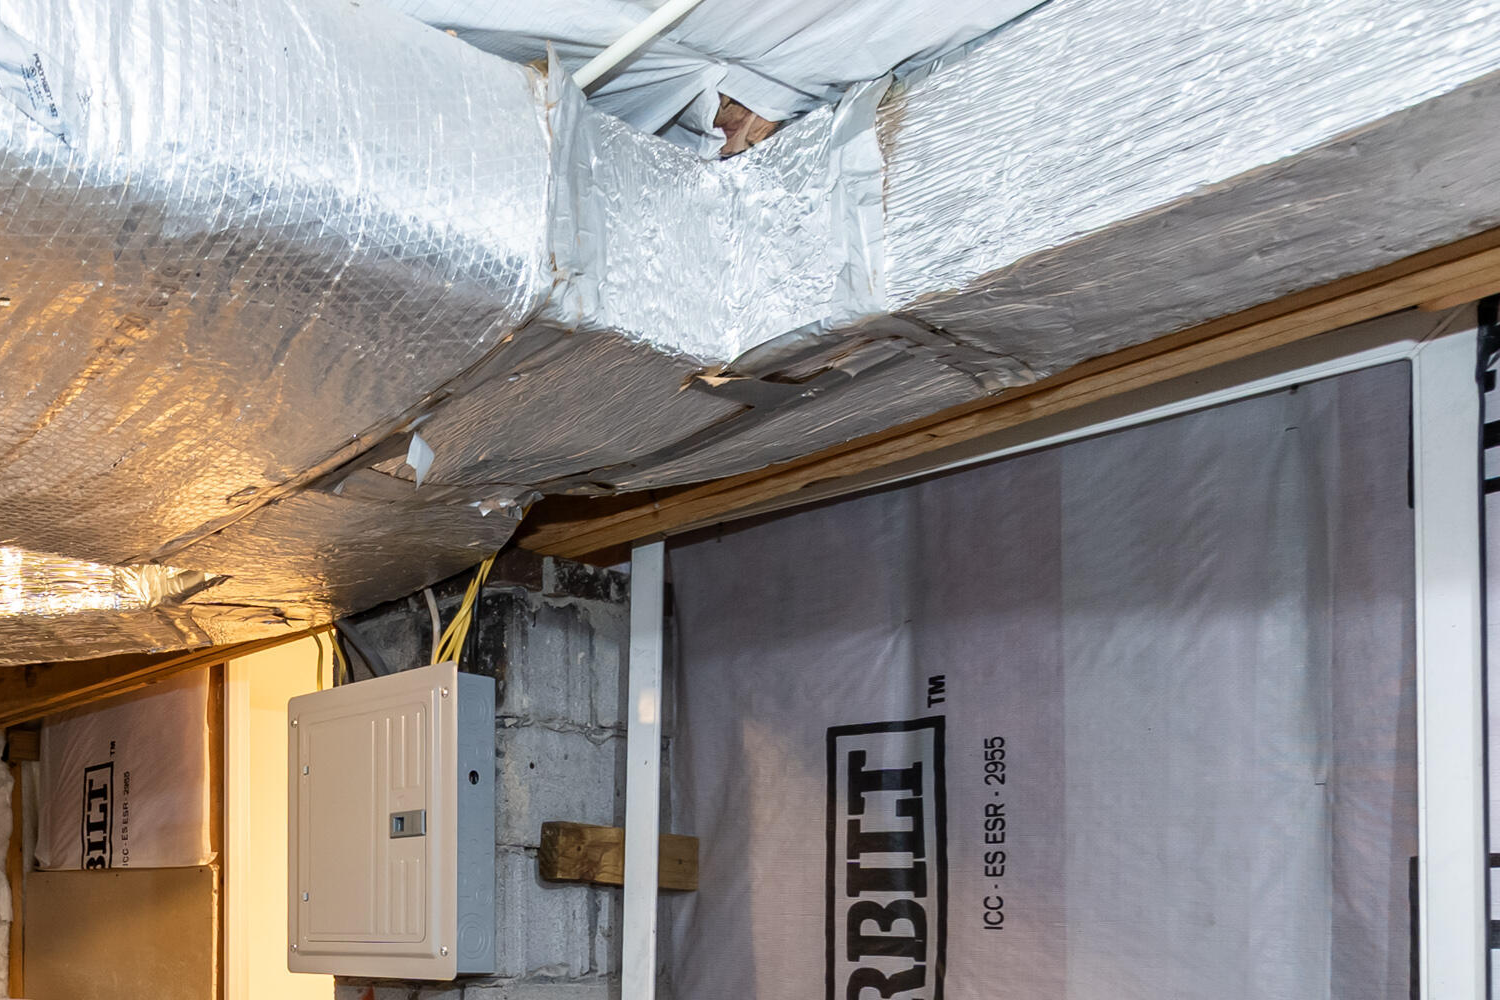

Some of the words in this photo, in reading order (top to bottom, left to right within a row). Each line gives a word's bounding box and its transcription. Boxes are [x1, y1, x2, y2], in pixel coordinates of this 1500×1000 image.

[984, 736, 1006, 785] 2955
[123, 771, 131, 796] 2955
[121, 826, 129, 841] ES
[984, 803, 1006, 845] ESR
[984, 850, 1006, 878] ES
[983, 896, 1005, 931] ICC
